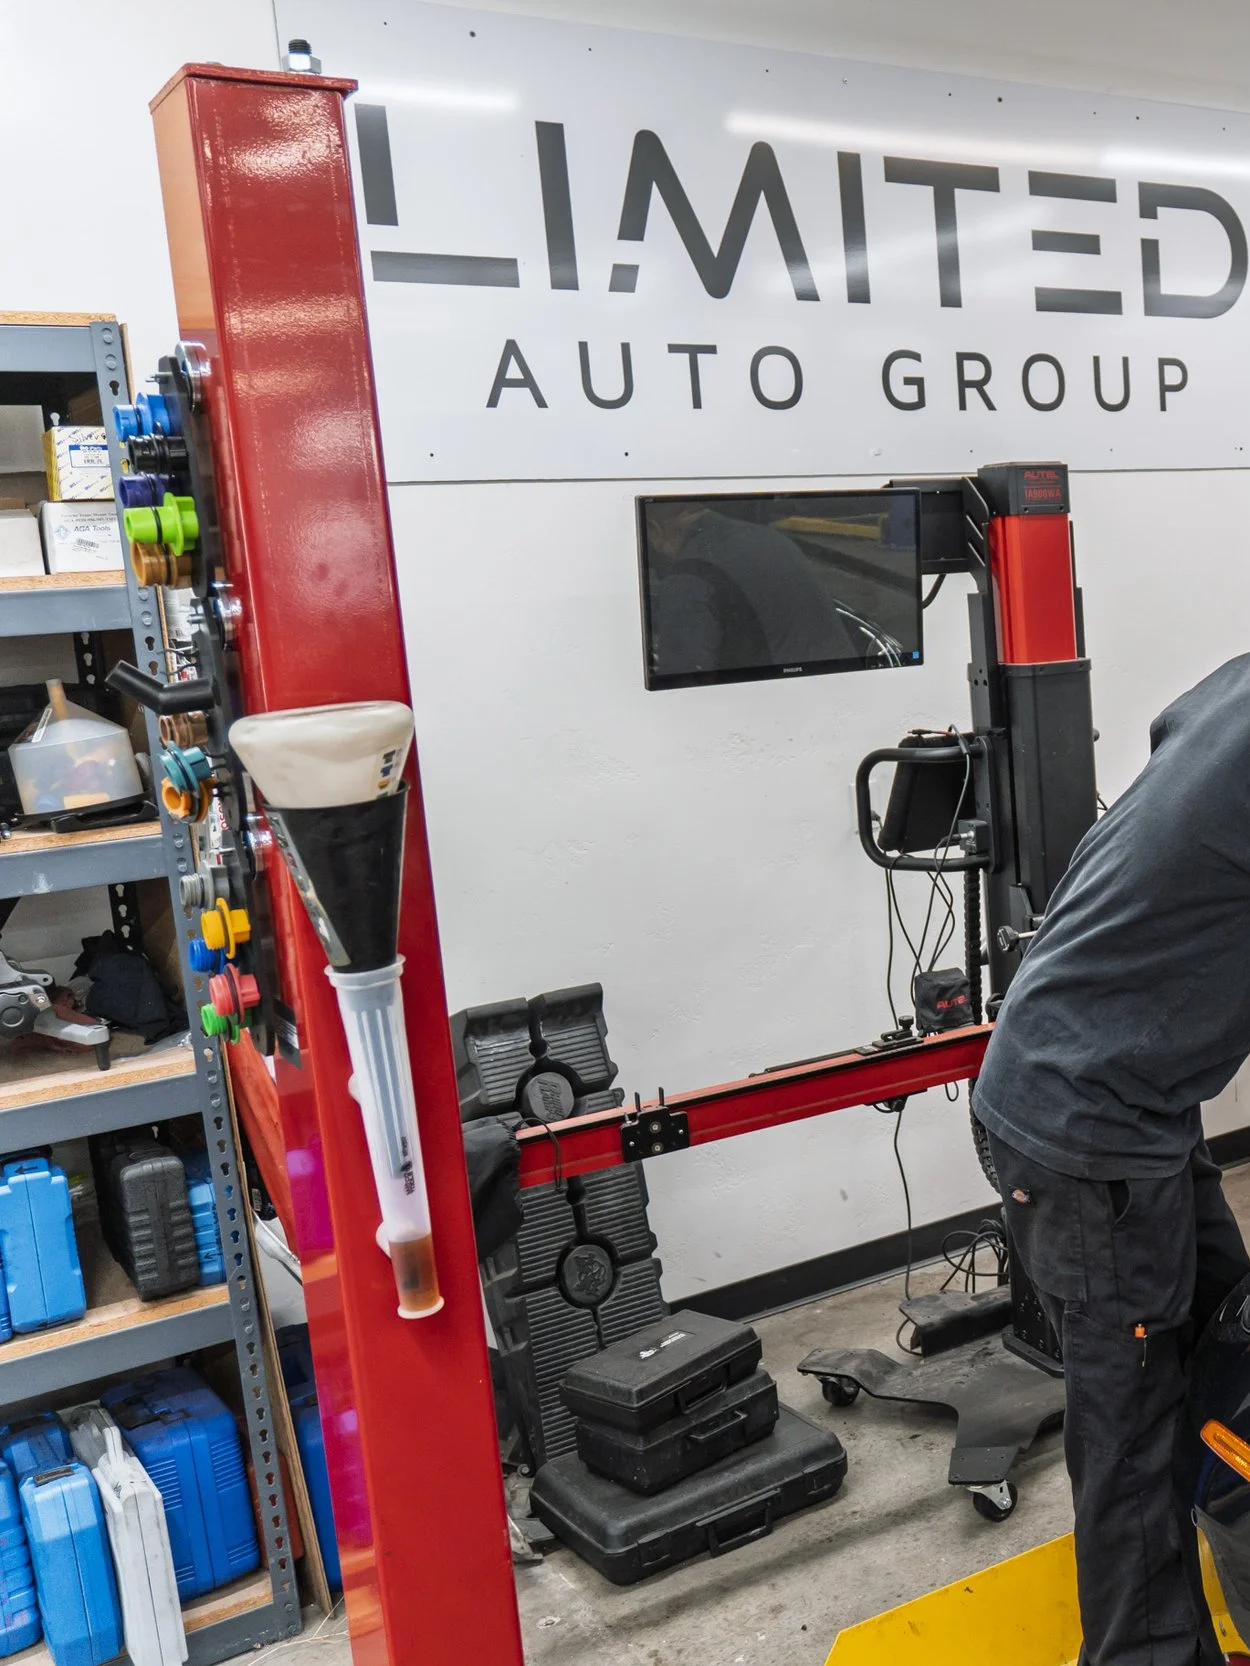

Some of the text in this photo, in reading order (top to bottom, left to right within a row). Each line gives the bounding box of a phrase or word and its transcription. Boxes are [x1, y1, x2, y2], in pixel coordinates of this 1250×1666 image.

[354, 103, 1248, 319] LIMITED
[486, 338, 1189, 412] AUTO GROUP
